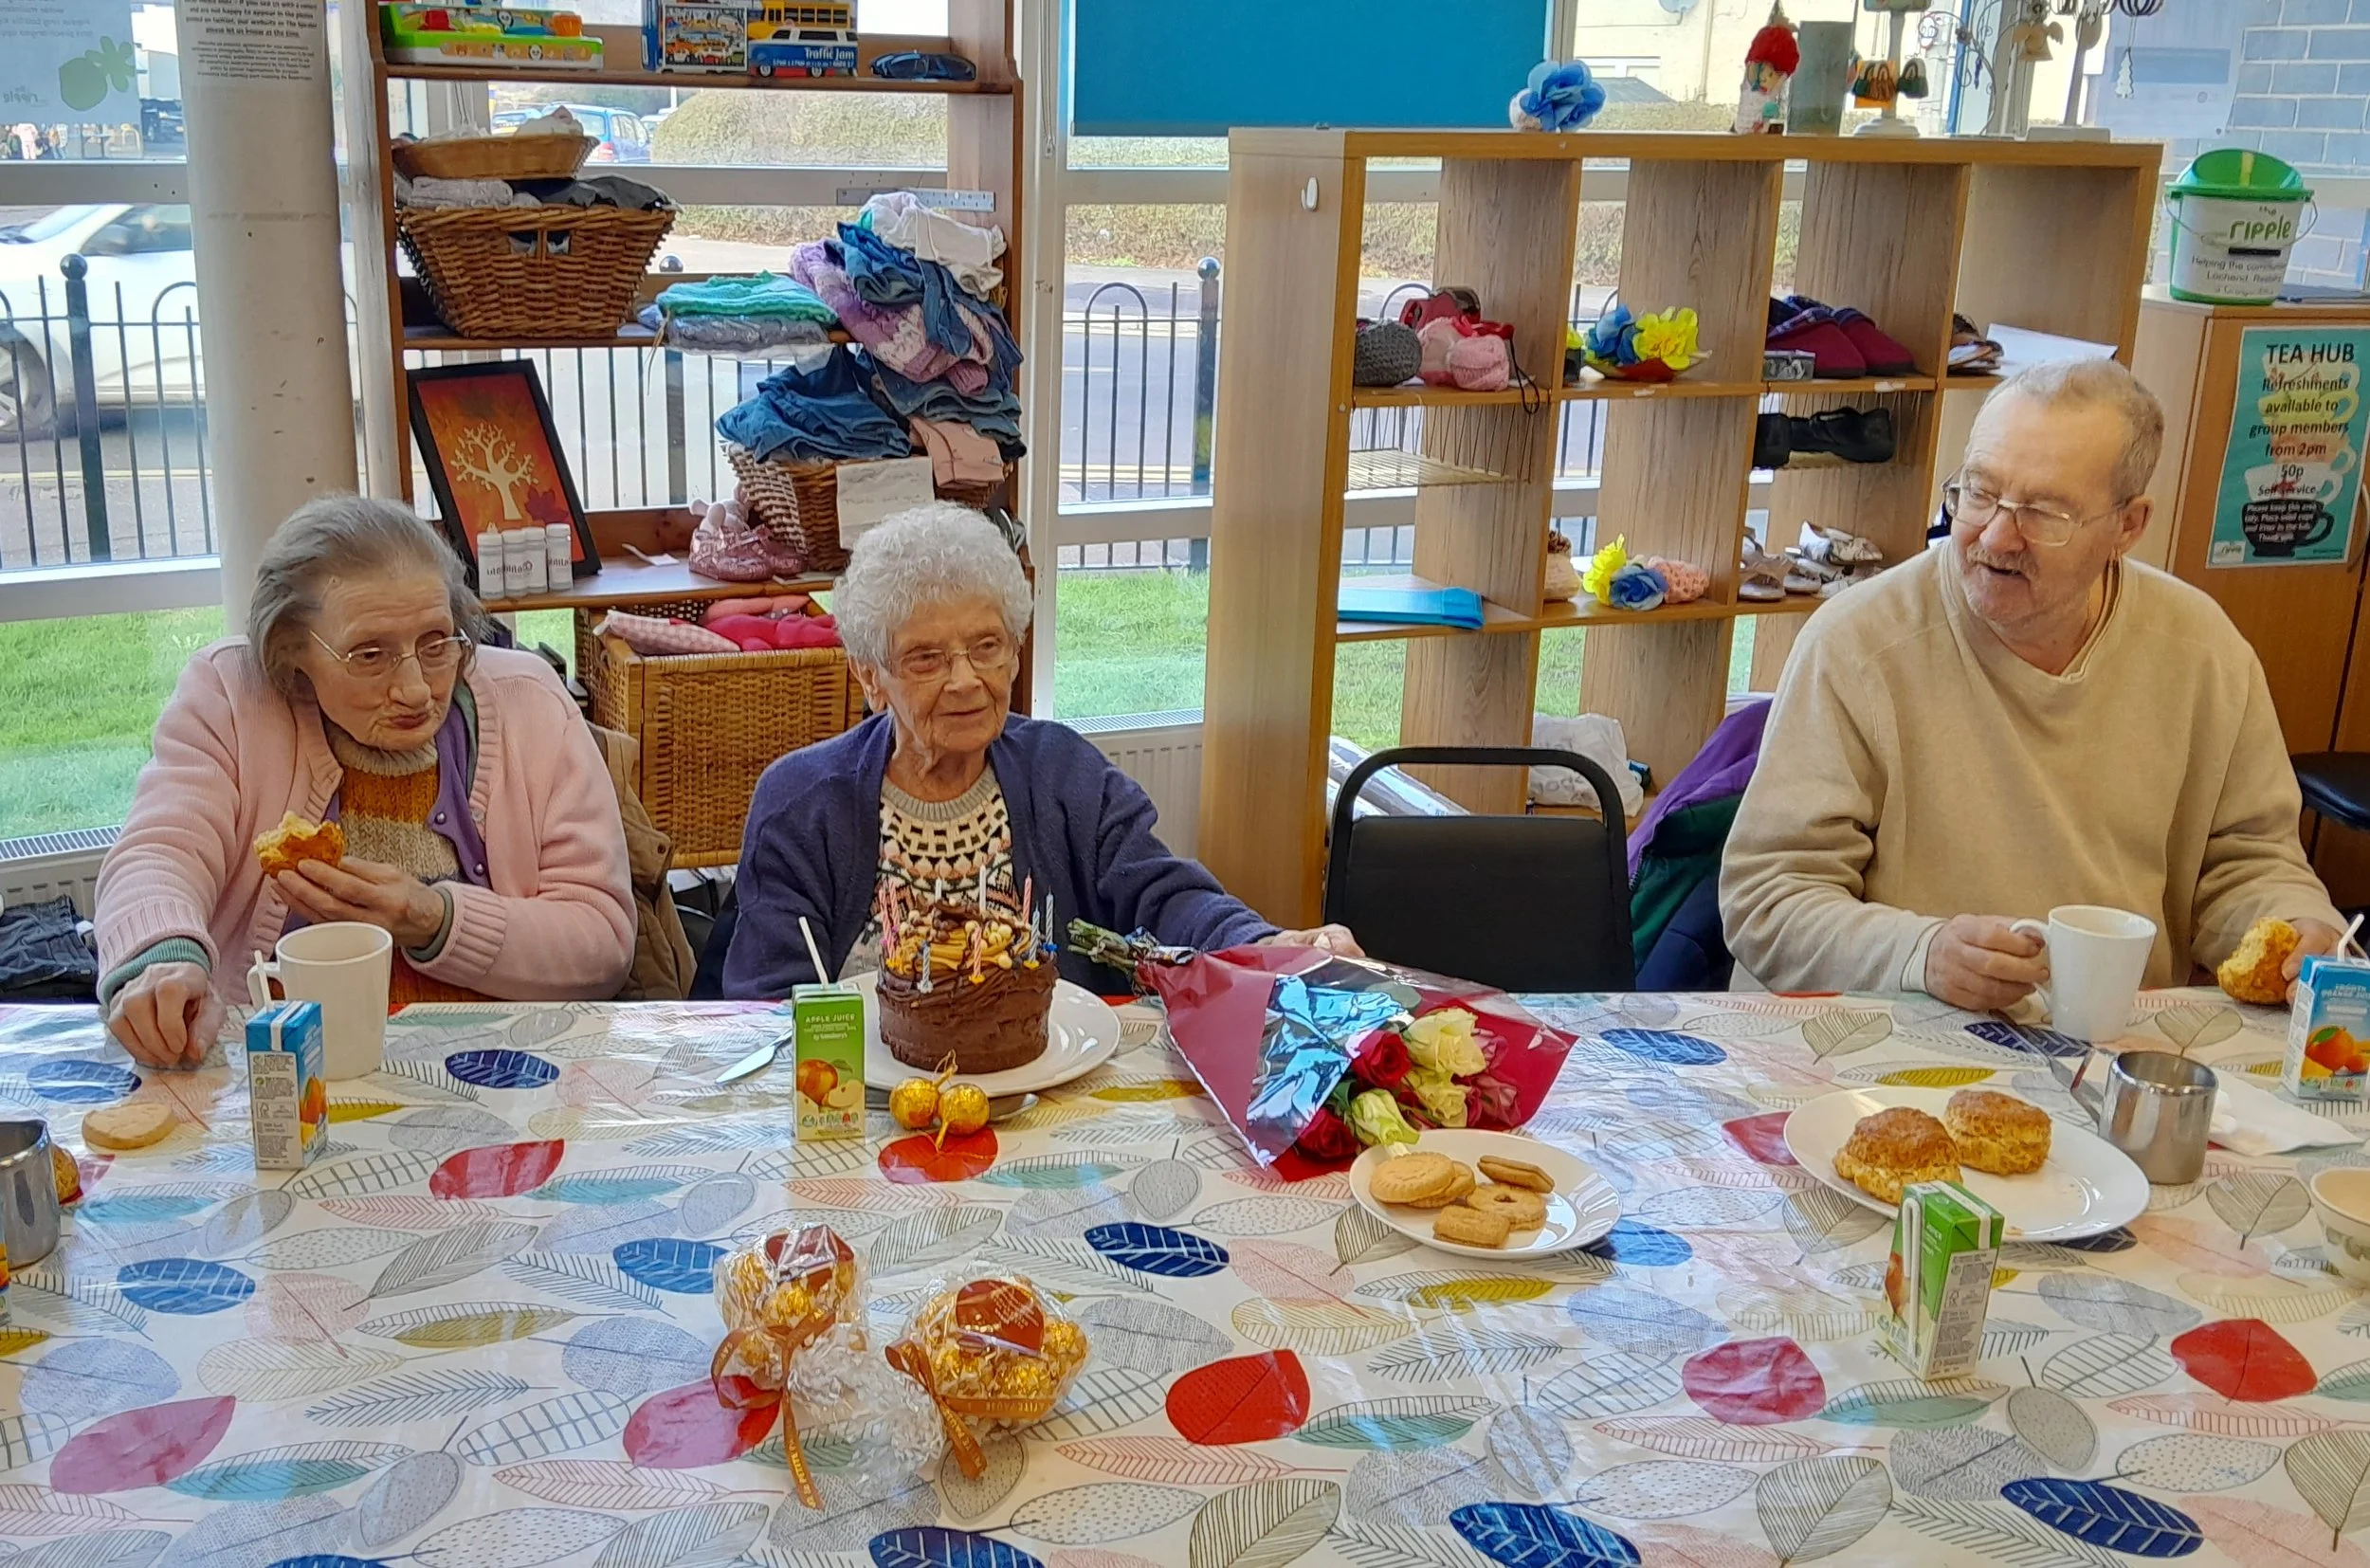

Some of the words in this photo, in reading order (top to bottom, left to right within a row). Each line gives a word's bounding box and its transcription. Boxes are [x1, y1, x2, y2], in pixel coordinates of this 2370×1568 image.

[804, 46, 834, 60] Traffic
[835, 47, 854, 61] Jam
[2230, 214, 2291, 242] ripple
[2266, 343, 2303, 364] TEA
[2311, 343, 2354, 362] HUB
[2262, 377, 2349, 392] Refreshments
[2265, 398, 2321, 413] available
[2325, 400, 2338, 411] to
[2249, 424, 2287, 439] group
[2290, 420, 2349, 437] members
[2266, 444, 2294, 457] from
[2298, 442, 2326, 457] 2pm
[2281, 465, 2304, 480] 50p
[805, 1015, 830, 1024] APPLE
[833, 1013, 855, 1022] JUICE
